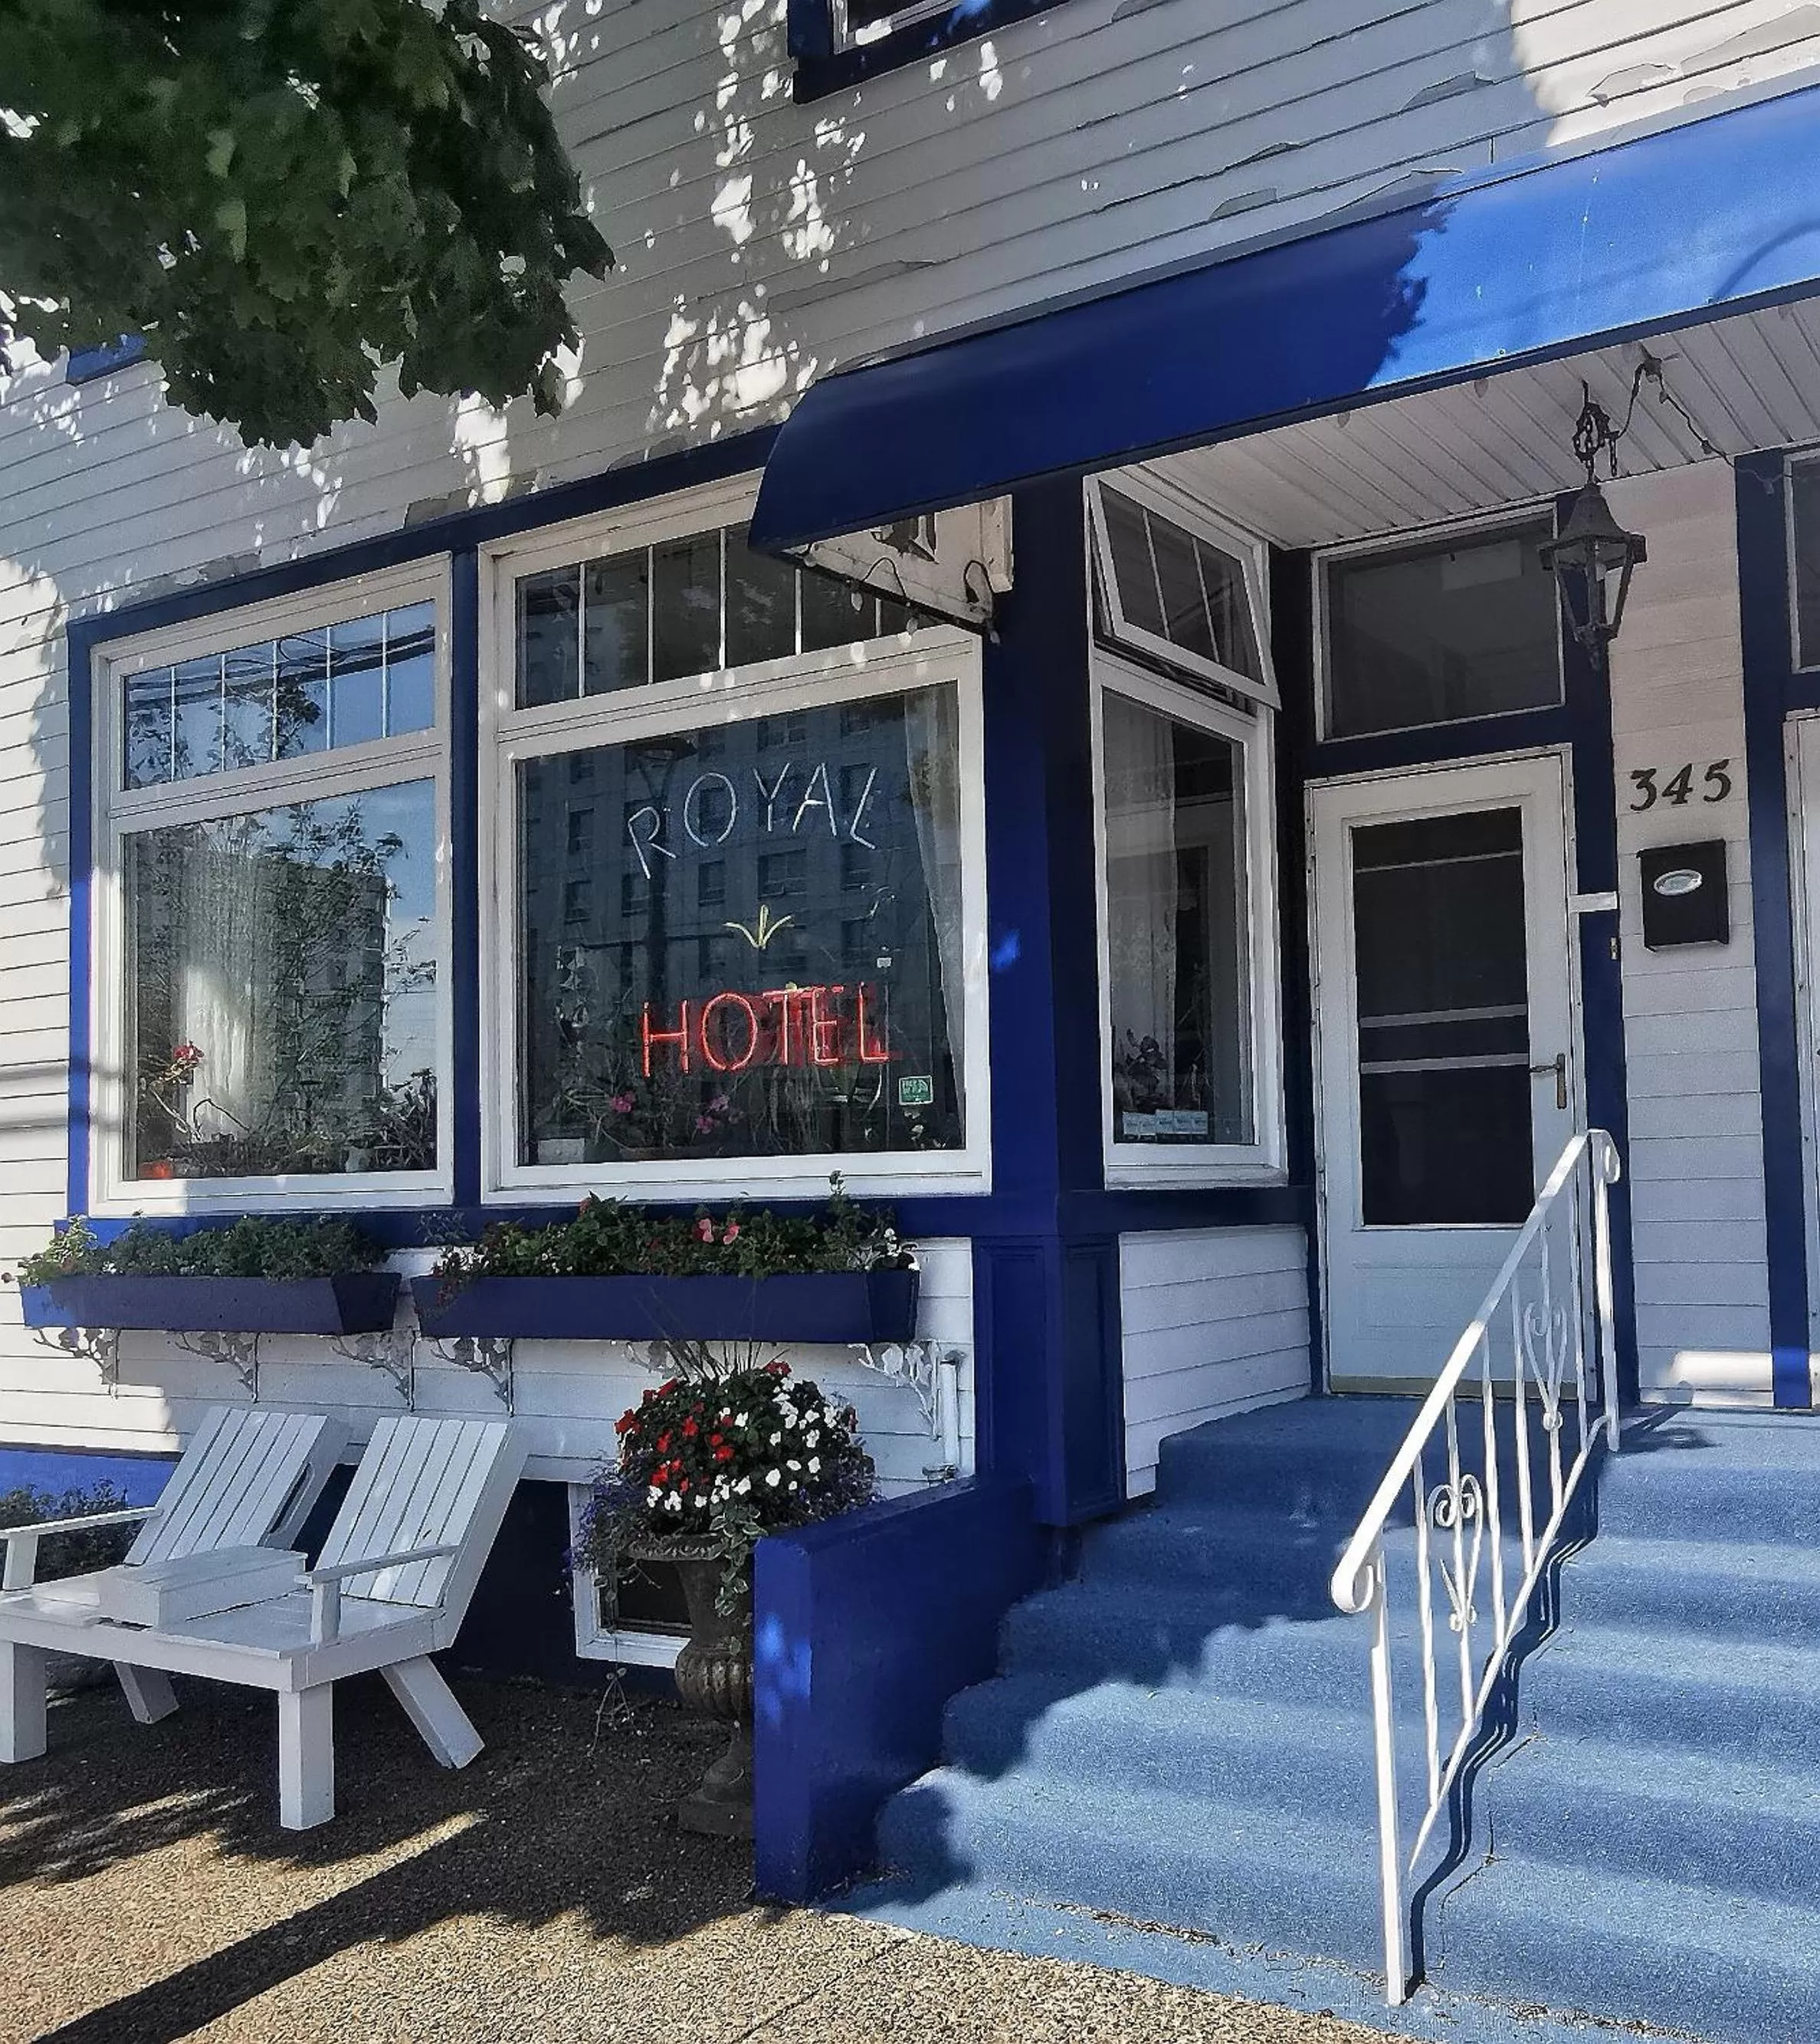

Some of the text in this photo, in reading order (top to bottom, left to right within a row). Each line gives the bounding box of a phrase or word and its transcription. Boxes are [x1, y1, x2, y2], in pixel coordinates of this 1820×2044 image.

[628, 763, 877, 879] ROYAL
[1630, 759, 1731, 811] 345
[642, 982, 890, 1077] HOTEL
